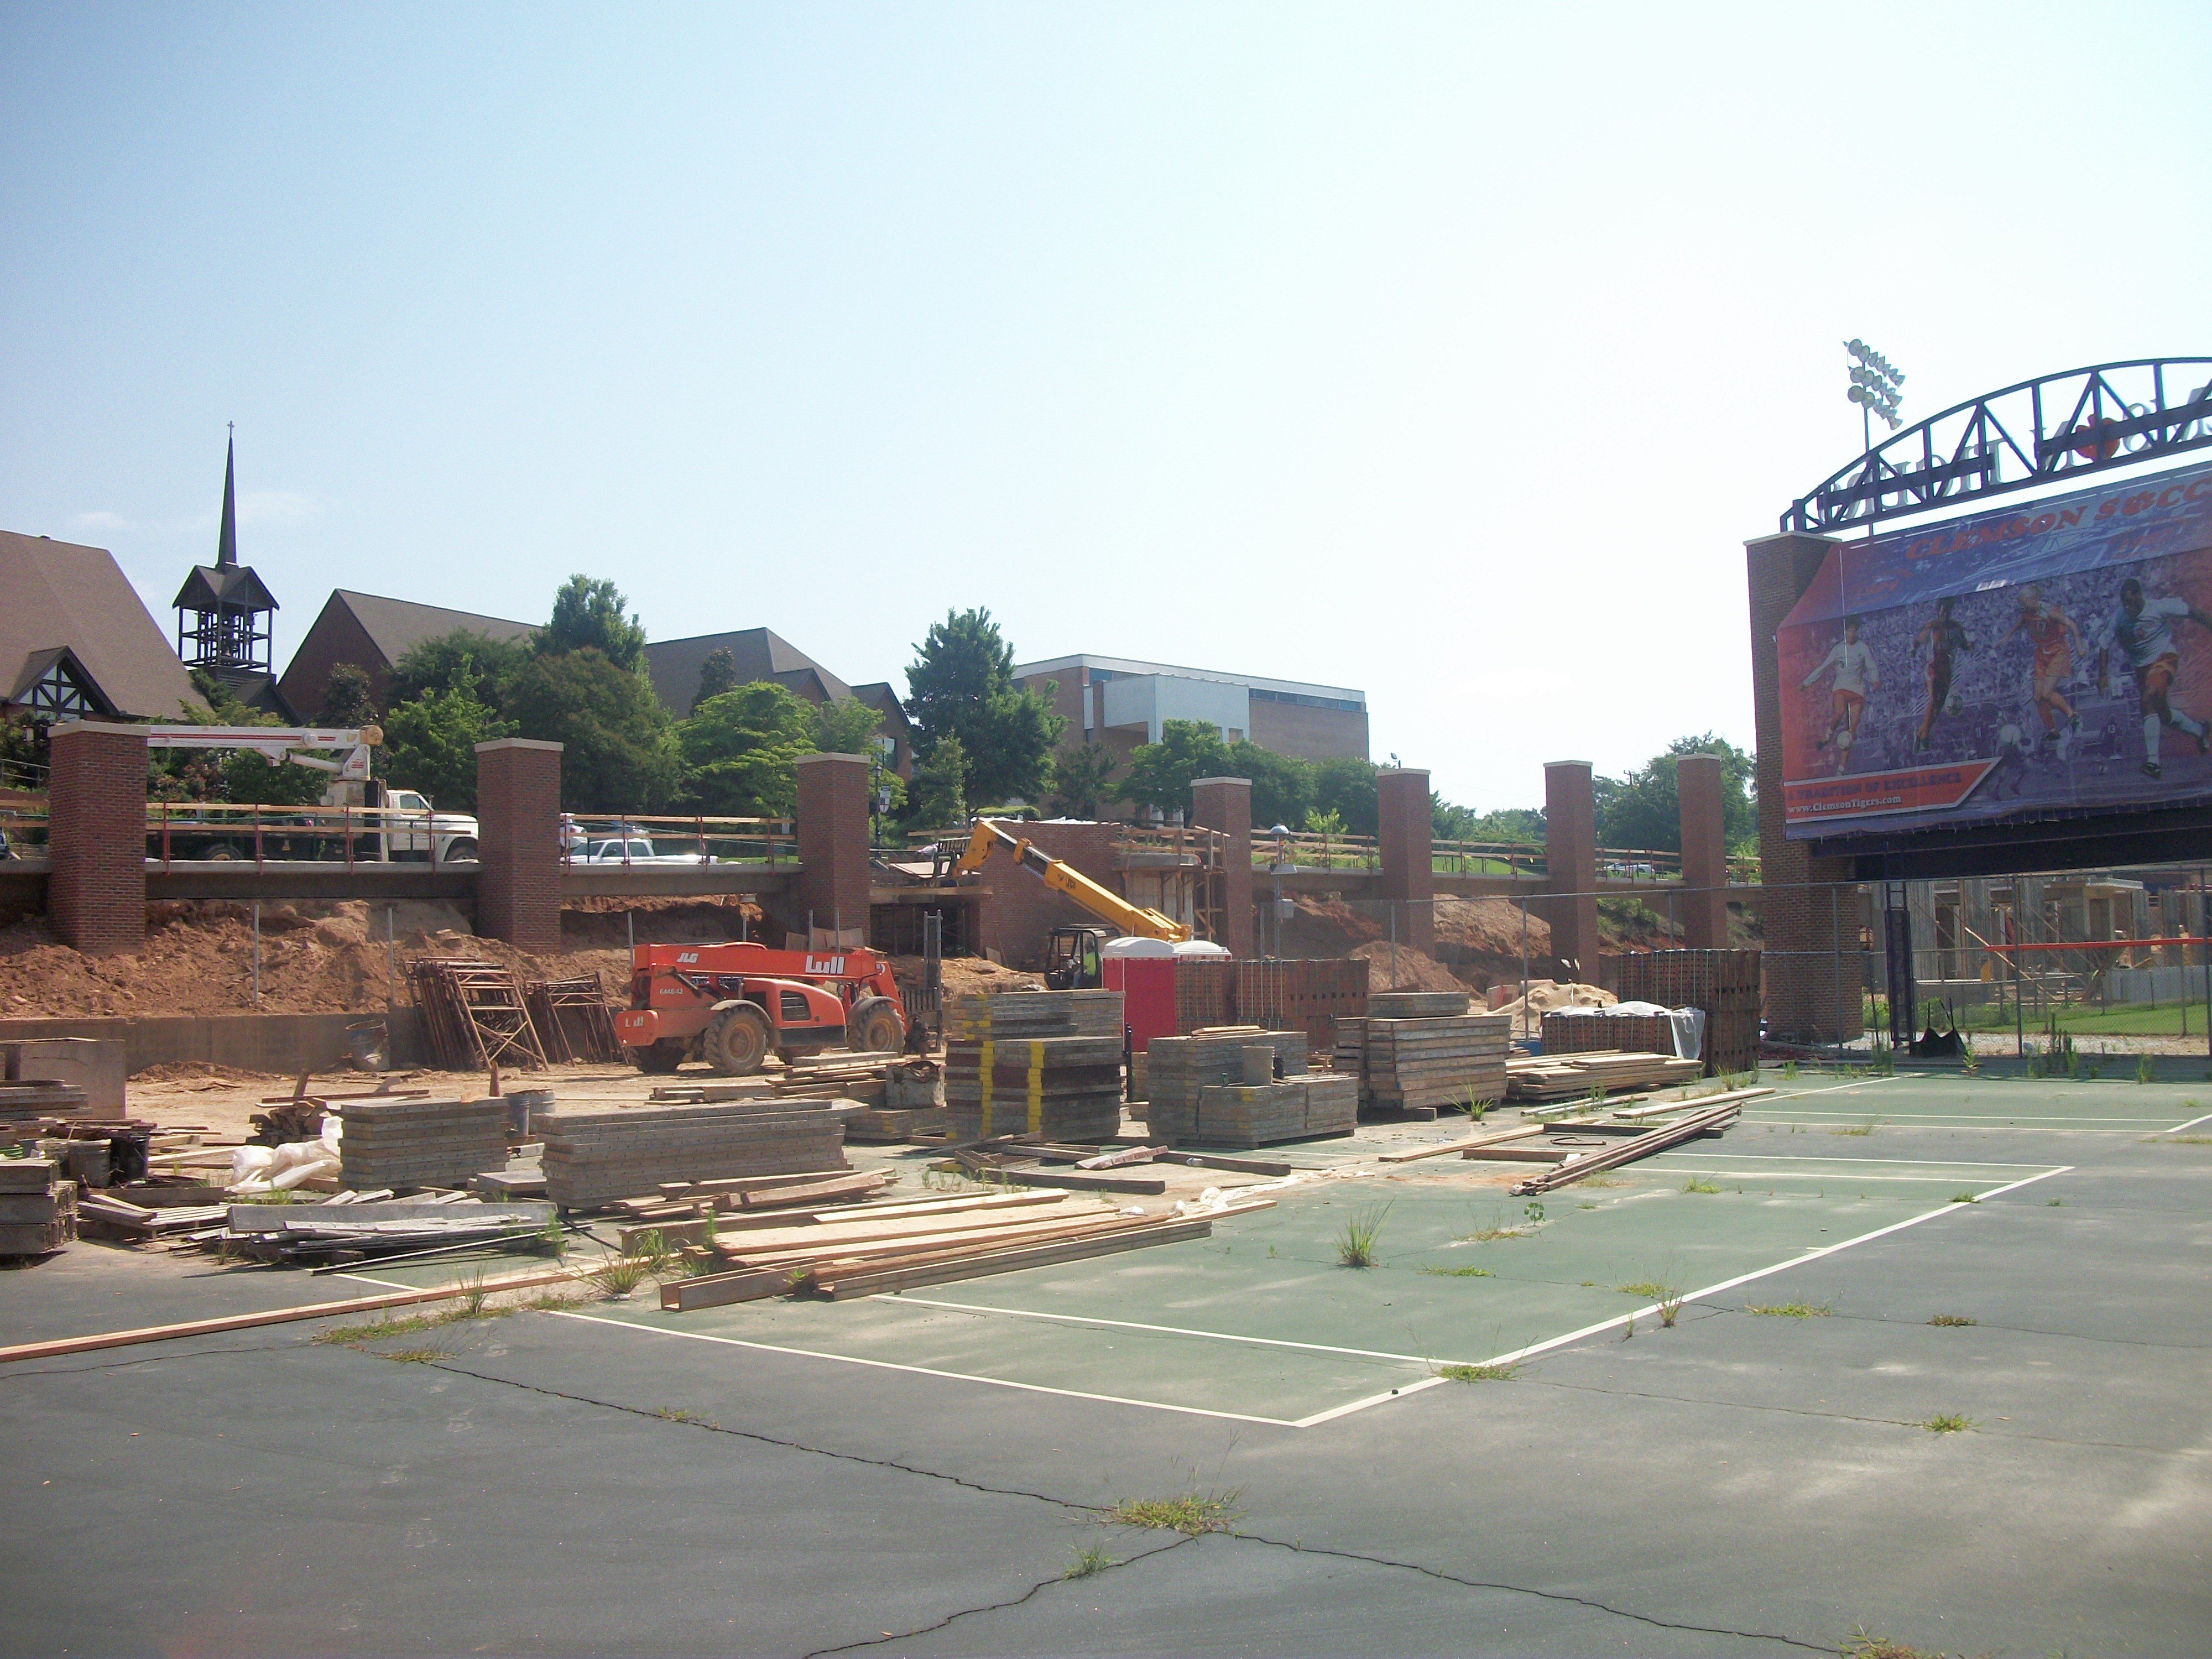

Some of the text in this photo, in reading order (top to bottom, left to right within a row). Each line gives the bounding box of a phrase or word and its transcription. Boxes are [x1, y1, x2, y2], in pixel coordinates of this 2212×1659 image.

[1905, 506, 2089, 560] CLEMSON
[1788, 796, 1901, 813] www.ClemsonTigers.com
[676, 952, 699, 963] JLG
[805, 955, 845, 974] Lull
